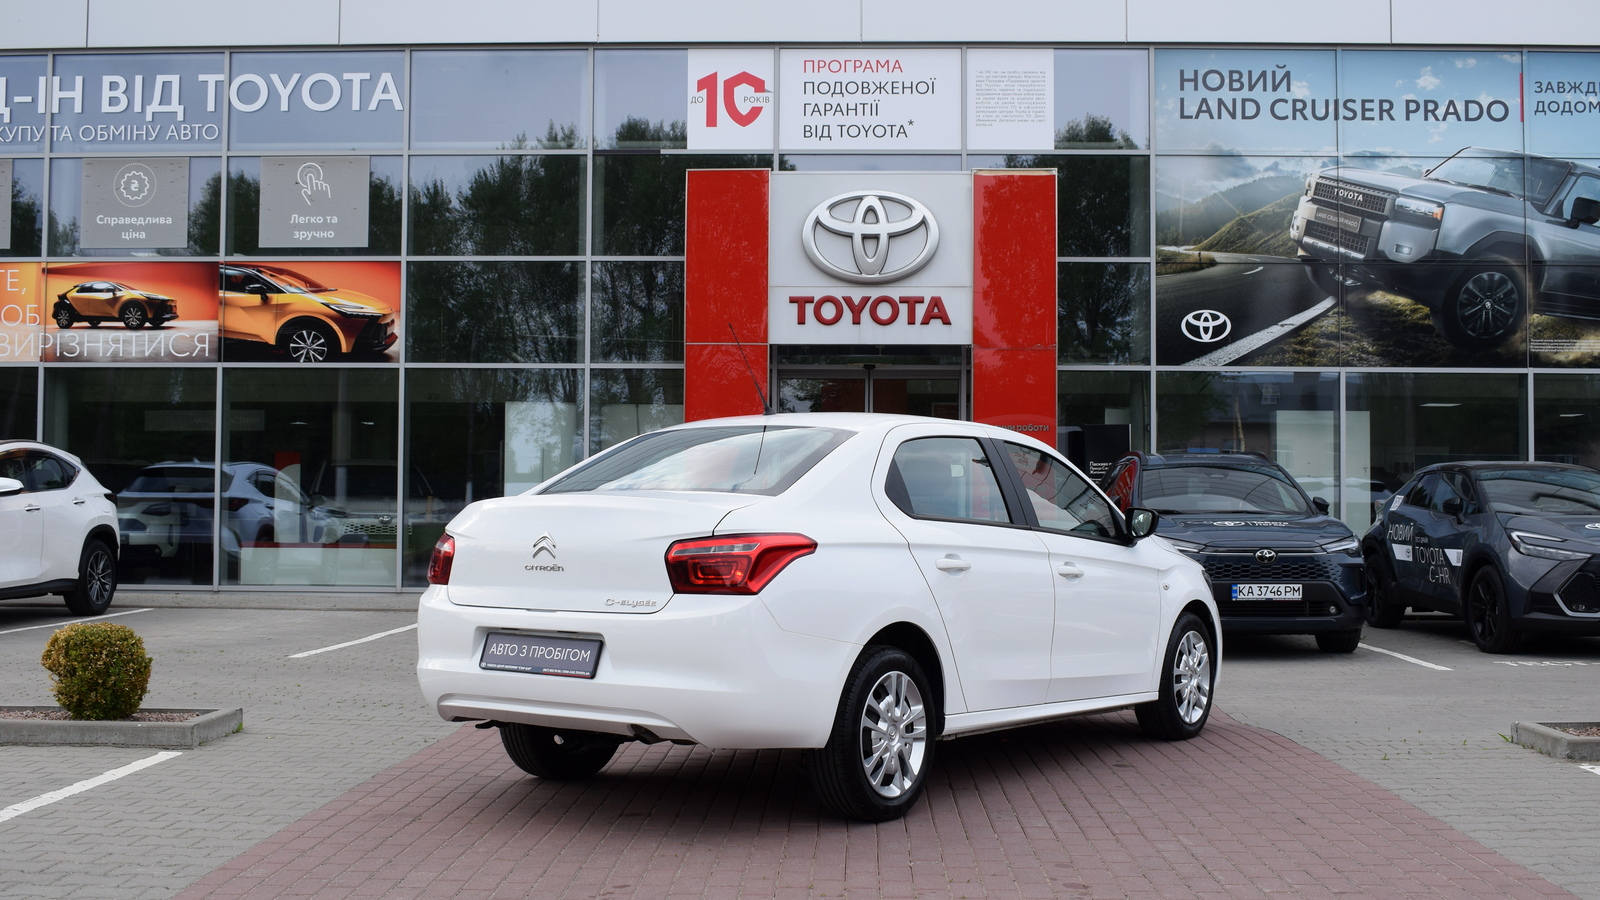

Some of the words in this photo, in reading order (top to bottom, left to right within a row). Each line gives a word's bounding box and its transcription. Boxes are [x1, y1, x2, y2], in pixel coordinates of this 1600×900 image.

[803, 59, 904, 74] ПРОГРАМА
[1178, 64, 1292, 92] НОВИЙ
[803, 78, 936, 98] ПОДОВЖЕНОЇ
[1533, 80, 1600, 97] ЗАВЖД
[0, 75, 84, 123] -ІН
[101, 74, 185, 121] ВІД
[198, 72, 404, 113] TOYOTA
[690, 95, 704, 105] ДО
[743, 95, 771, 104] РОКІВ
[803, 99, 880, 117] ГАРАНТІЇ
[1178, 97, 1261, 120] LAND
[1270, 98, 1396, 122] CRUISER
[1405, 99, 1510, 123] PRADO
[51, 125, 73, 142] ТА
[79, 124, 162, 141] ОБМІНУ
[166, 123, 219, 141] АВТО
[803, 124, 832, 141] ВІД
[1334, 188, 1363, 202] TOYOTA
[96, 214, 173, 227] Справедлива
[290, 213, 323, 226] Легко
[325, 215, 338, 224] та
[121, 228, 146, 241] ціна
[293, 228, 335, 241] зручно
[788, 294, 952, 326] TOYOTA
[0, 332, 210, 357] ВИРІЗНЯТИСЯ
[1016, 423, 1050, 433] роботи
[1386, 522, 1414, 541] НОВИЙ
[1415, 546, 1446, 565] TOYOTA
[1428, 565, 1452, 584] C-HR
[1238, 586, 1254, 597] KA
[1257, 586, 1282, 597] 3746
[1284, 586, 1301, 597] PM
[489, 643, 518, 656] АВТО
[519, 645, 527, 657] З
[529, 645, 591, 662] ПРОБІГОМ
